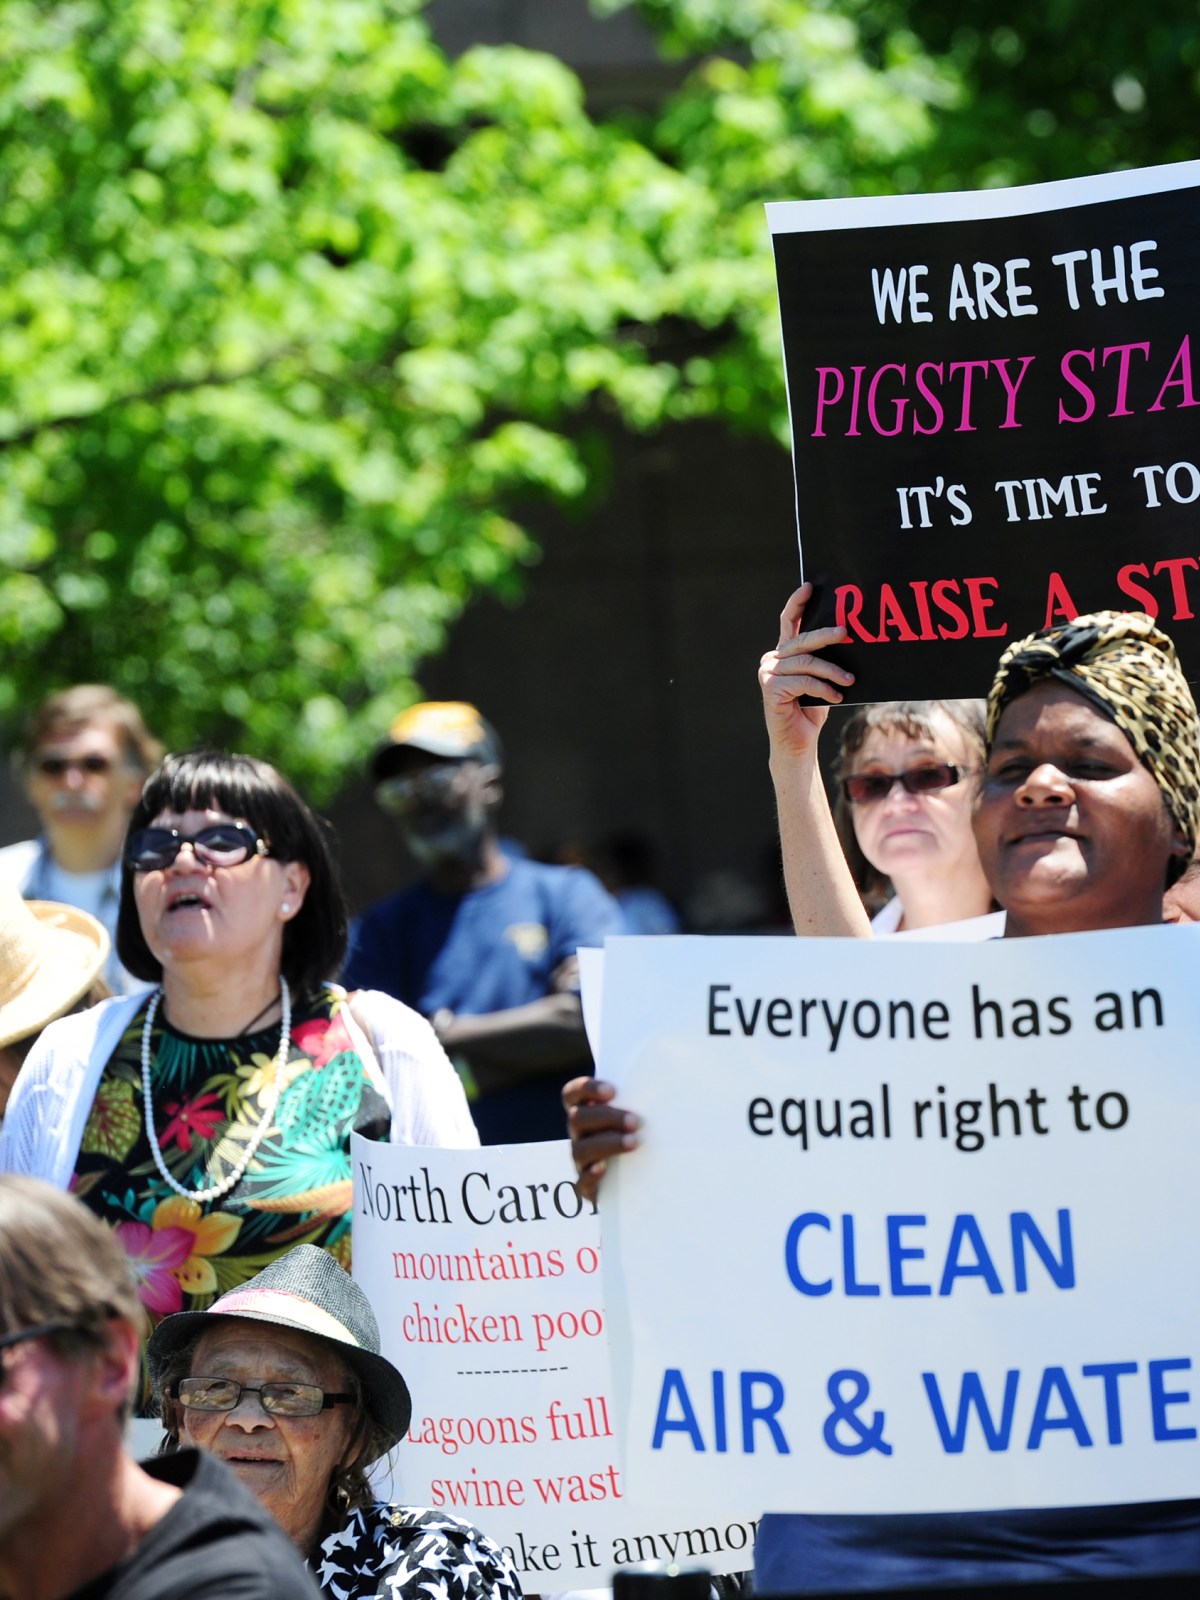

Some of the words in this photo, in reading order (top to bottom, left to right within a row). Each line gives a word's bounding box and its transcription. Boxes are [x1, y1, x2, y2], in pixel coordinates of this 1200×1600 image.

[871, 264, 934, 325] WE
[948, 258, 1039, 322] ARE
[1051, 240, 1165, 311] THE
[810, 355, 1036, 438] PIGSTY
[896, 475, 973, 529] IT'S
[994, 472, 1108, 522] TIME
[834, 577, 1008, 645] RAISE
[1043, 572, 1079, 632] A
[707, 984, 950, 1052] Everyone
[971, 985, 1072, 1039] has
[1094, 987, 1164, 1032] an
[747, 1084, 891, 1150] equal
[914, 1082, 1048, 1152] right
[1068, 1085, 1130, 1133] to
[359, 1162, 453, 1224] North
[393, 1241, 565, 1281] mountains
[784, 1208, 1076, 1297] CLEAN
[403, 1302, 523, 1344] chicken
[532, 1308, 609, 1352] poo
[547, 1396, 613, 1441] full
[652, 1368, 791, 1455] AIR
[823, 1369, 893, 1456] &
[431, 1467, 525, 1507] swine
[571, 1529, 601, 1568] it
